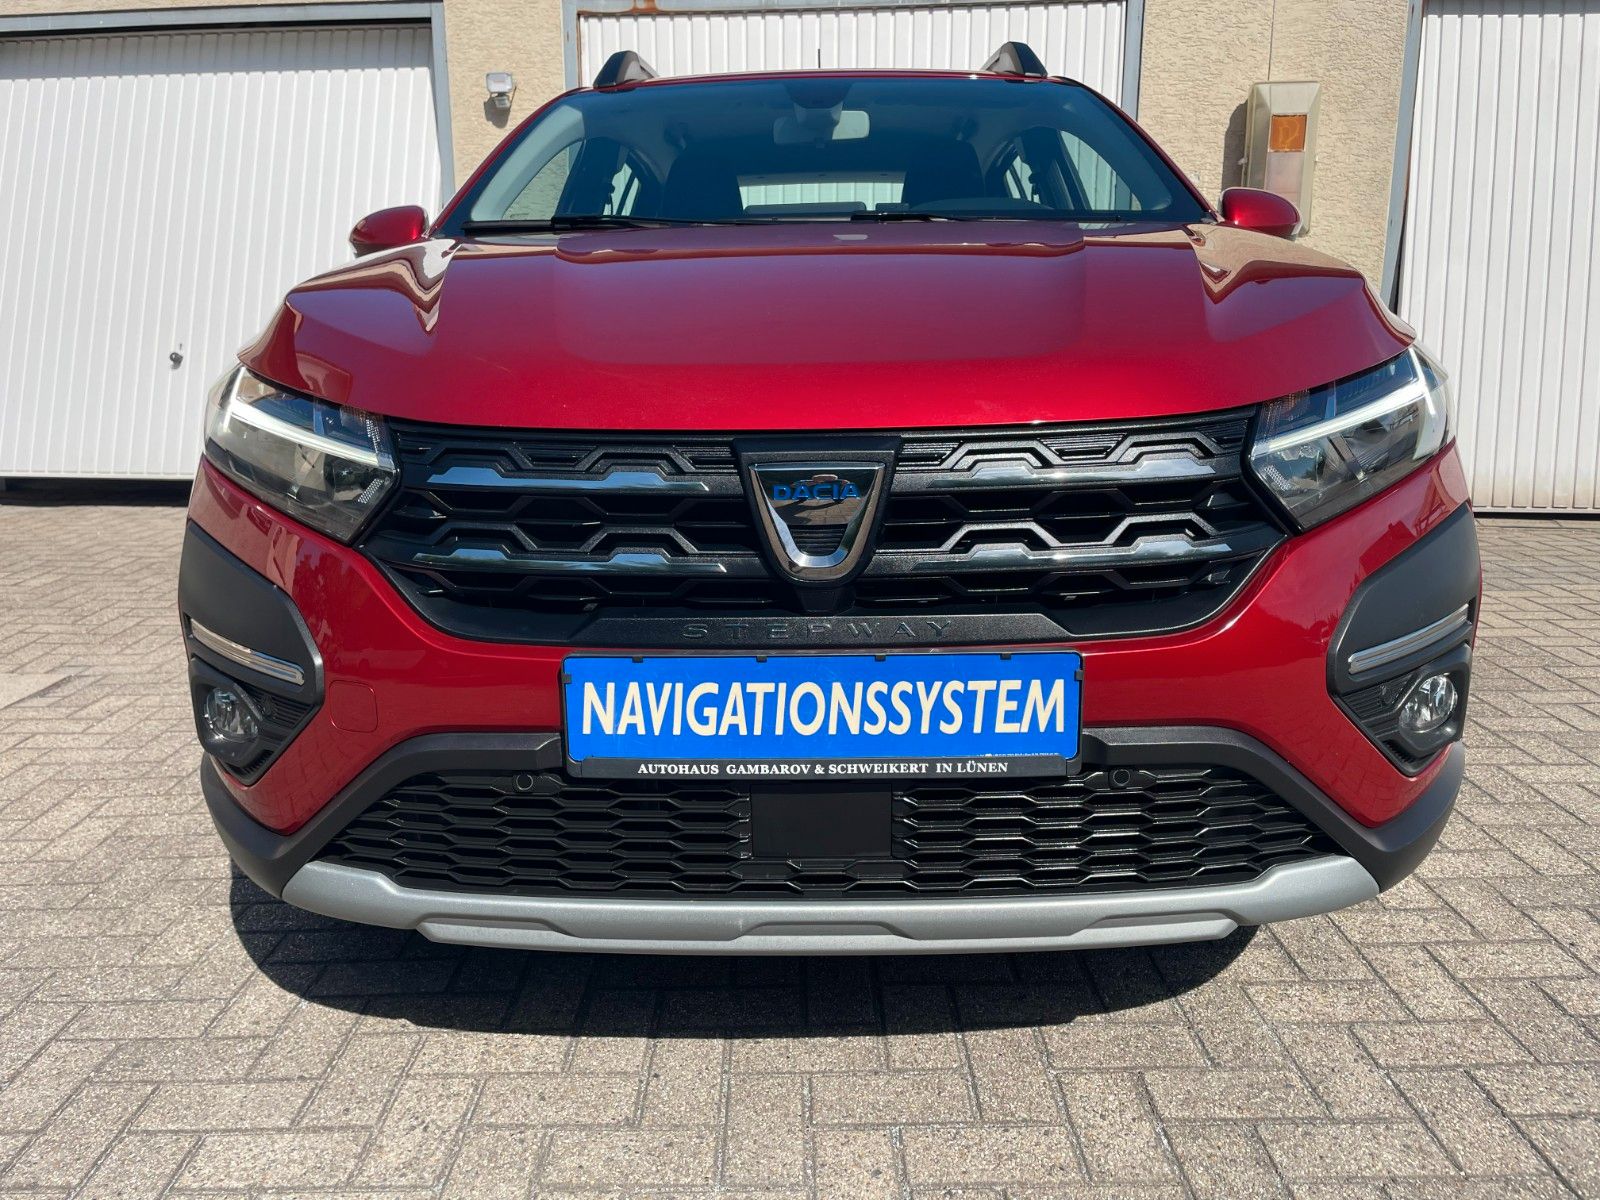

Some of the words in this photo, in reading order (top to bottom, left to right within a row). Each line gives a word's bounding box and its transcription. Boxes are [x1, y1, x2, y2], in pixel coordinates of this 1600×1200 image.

[772, 483, 861, 500] DACIA
[682, 621, 951, 639] STEPWAY
[582, 679, 1065, 736] NAVIGATIONSSYSTEM
[637, 763, 719, 775] AUTOHAUS
[725, 763, 811, 775] GAMBAROV
[814, 763, 825, 775] &
[828, 762, 930, 775] SCHWEIKERT
[935, 762, 953, 774] IN
[956, 760, 1009, 773] LÜNEN
